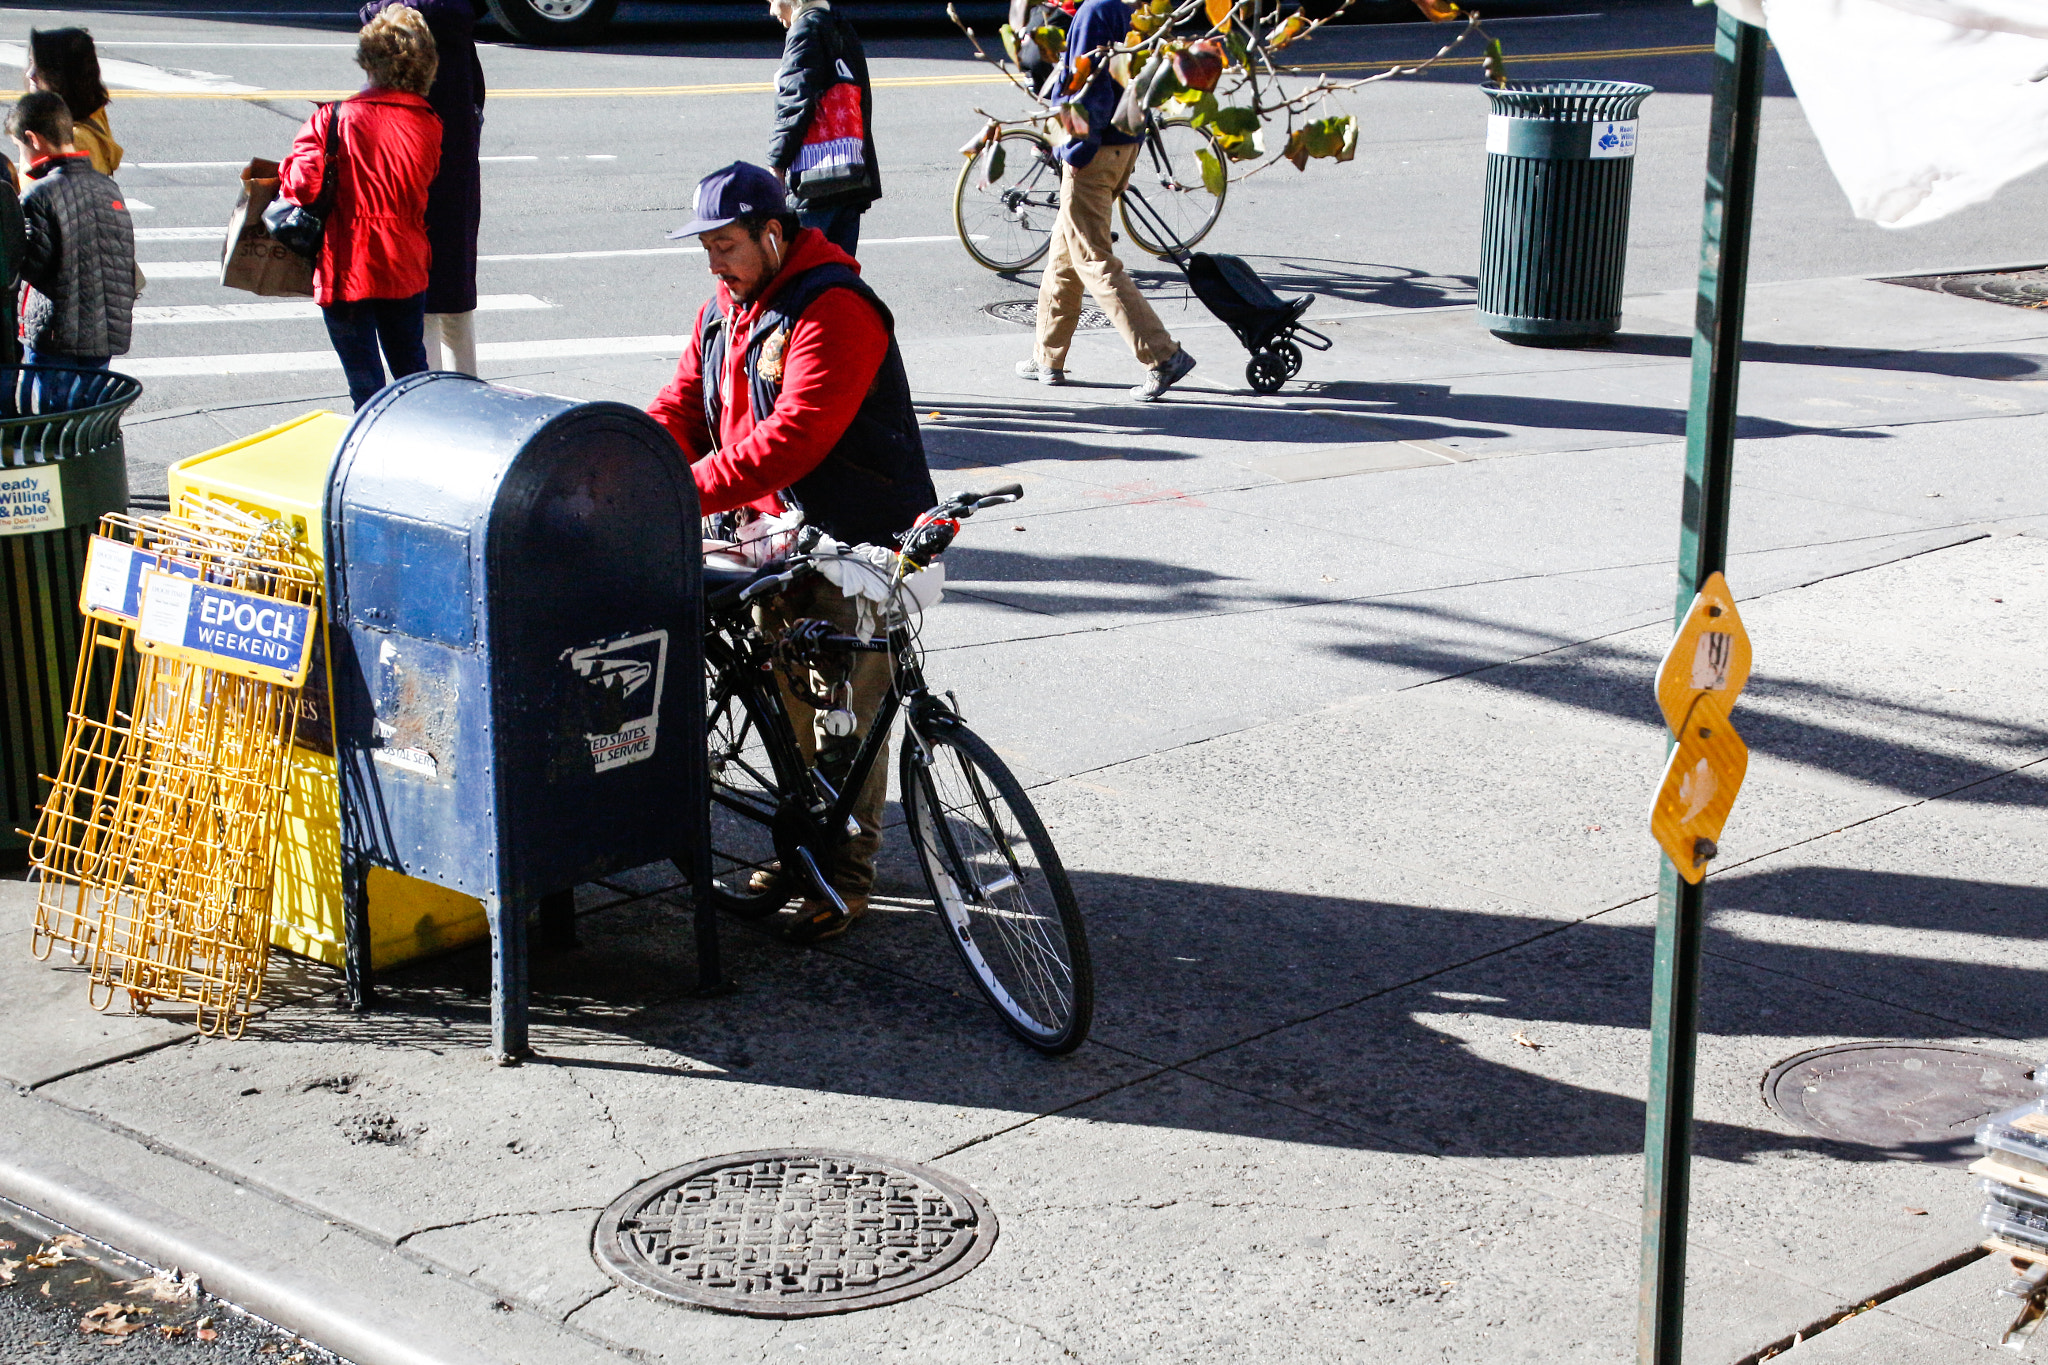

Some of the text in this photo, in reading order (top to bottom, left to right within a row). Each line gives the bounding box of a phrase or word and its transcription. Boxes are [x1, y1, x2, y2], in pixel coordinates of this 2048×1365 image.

[0, 477, 38, 491] eady
[0, 489, 50, 504] Willing
[13, 504, 46, 516] Able
[200, 595, 294, 641] EPOCH
[199, 626, 290, 661] WEEKEND
[609, 725, 647, 746] STATES
[608, 738, 650, 762] SERVICE
